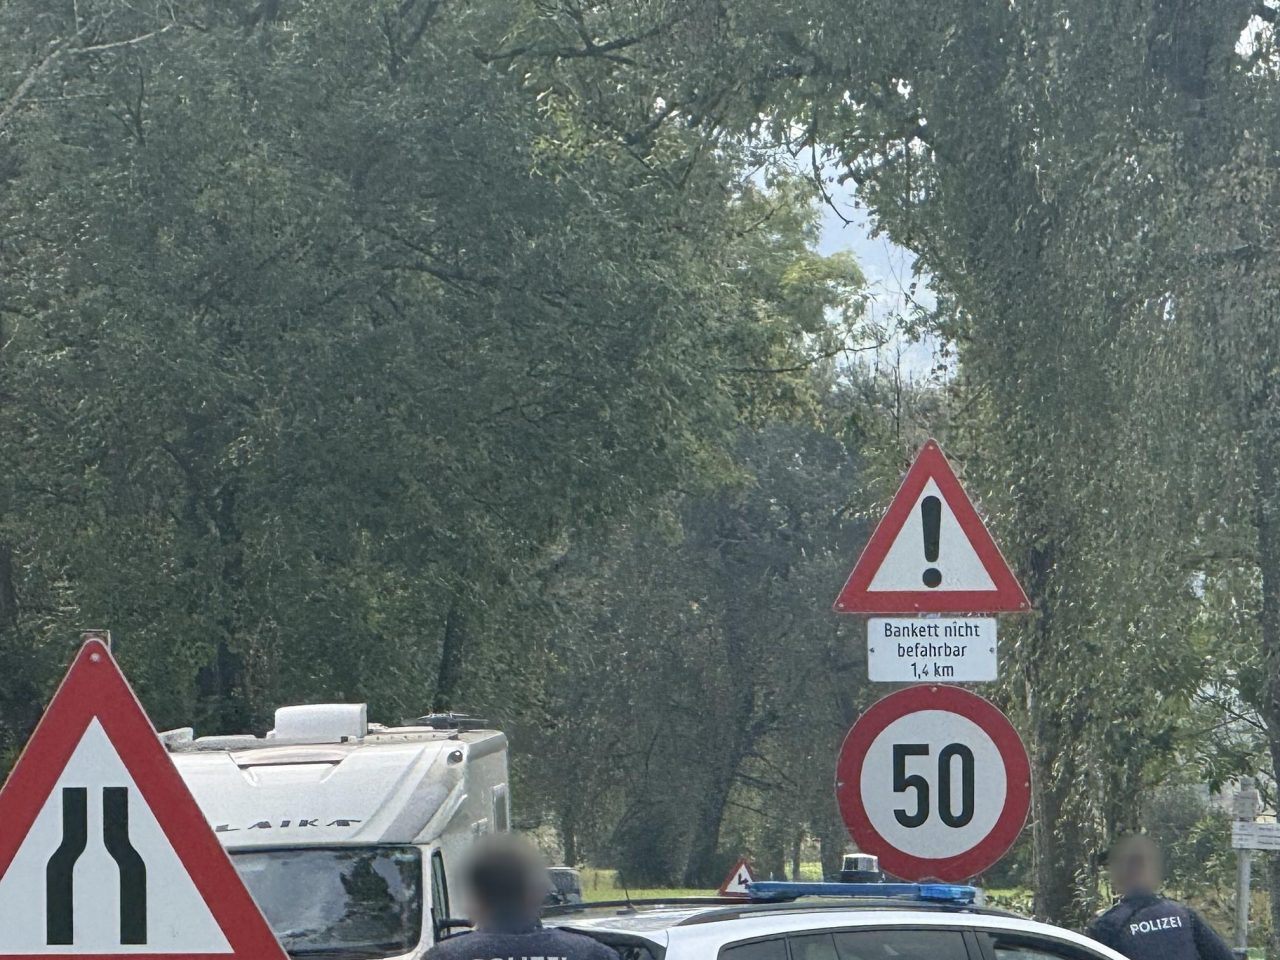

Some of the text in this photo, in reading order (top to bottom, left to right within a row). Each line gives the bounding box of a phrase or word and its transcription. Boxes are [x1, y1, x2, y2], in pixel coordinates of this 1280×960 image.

[884, 621, 980, 637] Bankett nicht
[898, 643, 967, 657] befahrbar
[911, 662, 954, 679] 1,4 km
[893, 743, 974, 828] 50
[215, 819, 361, 832] LAIKA
[1130, 916, 1182, 936] POLIZEI
